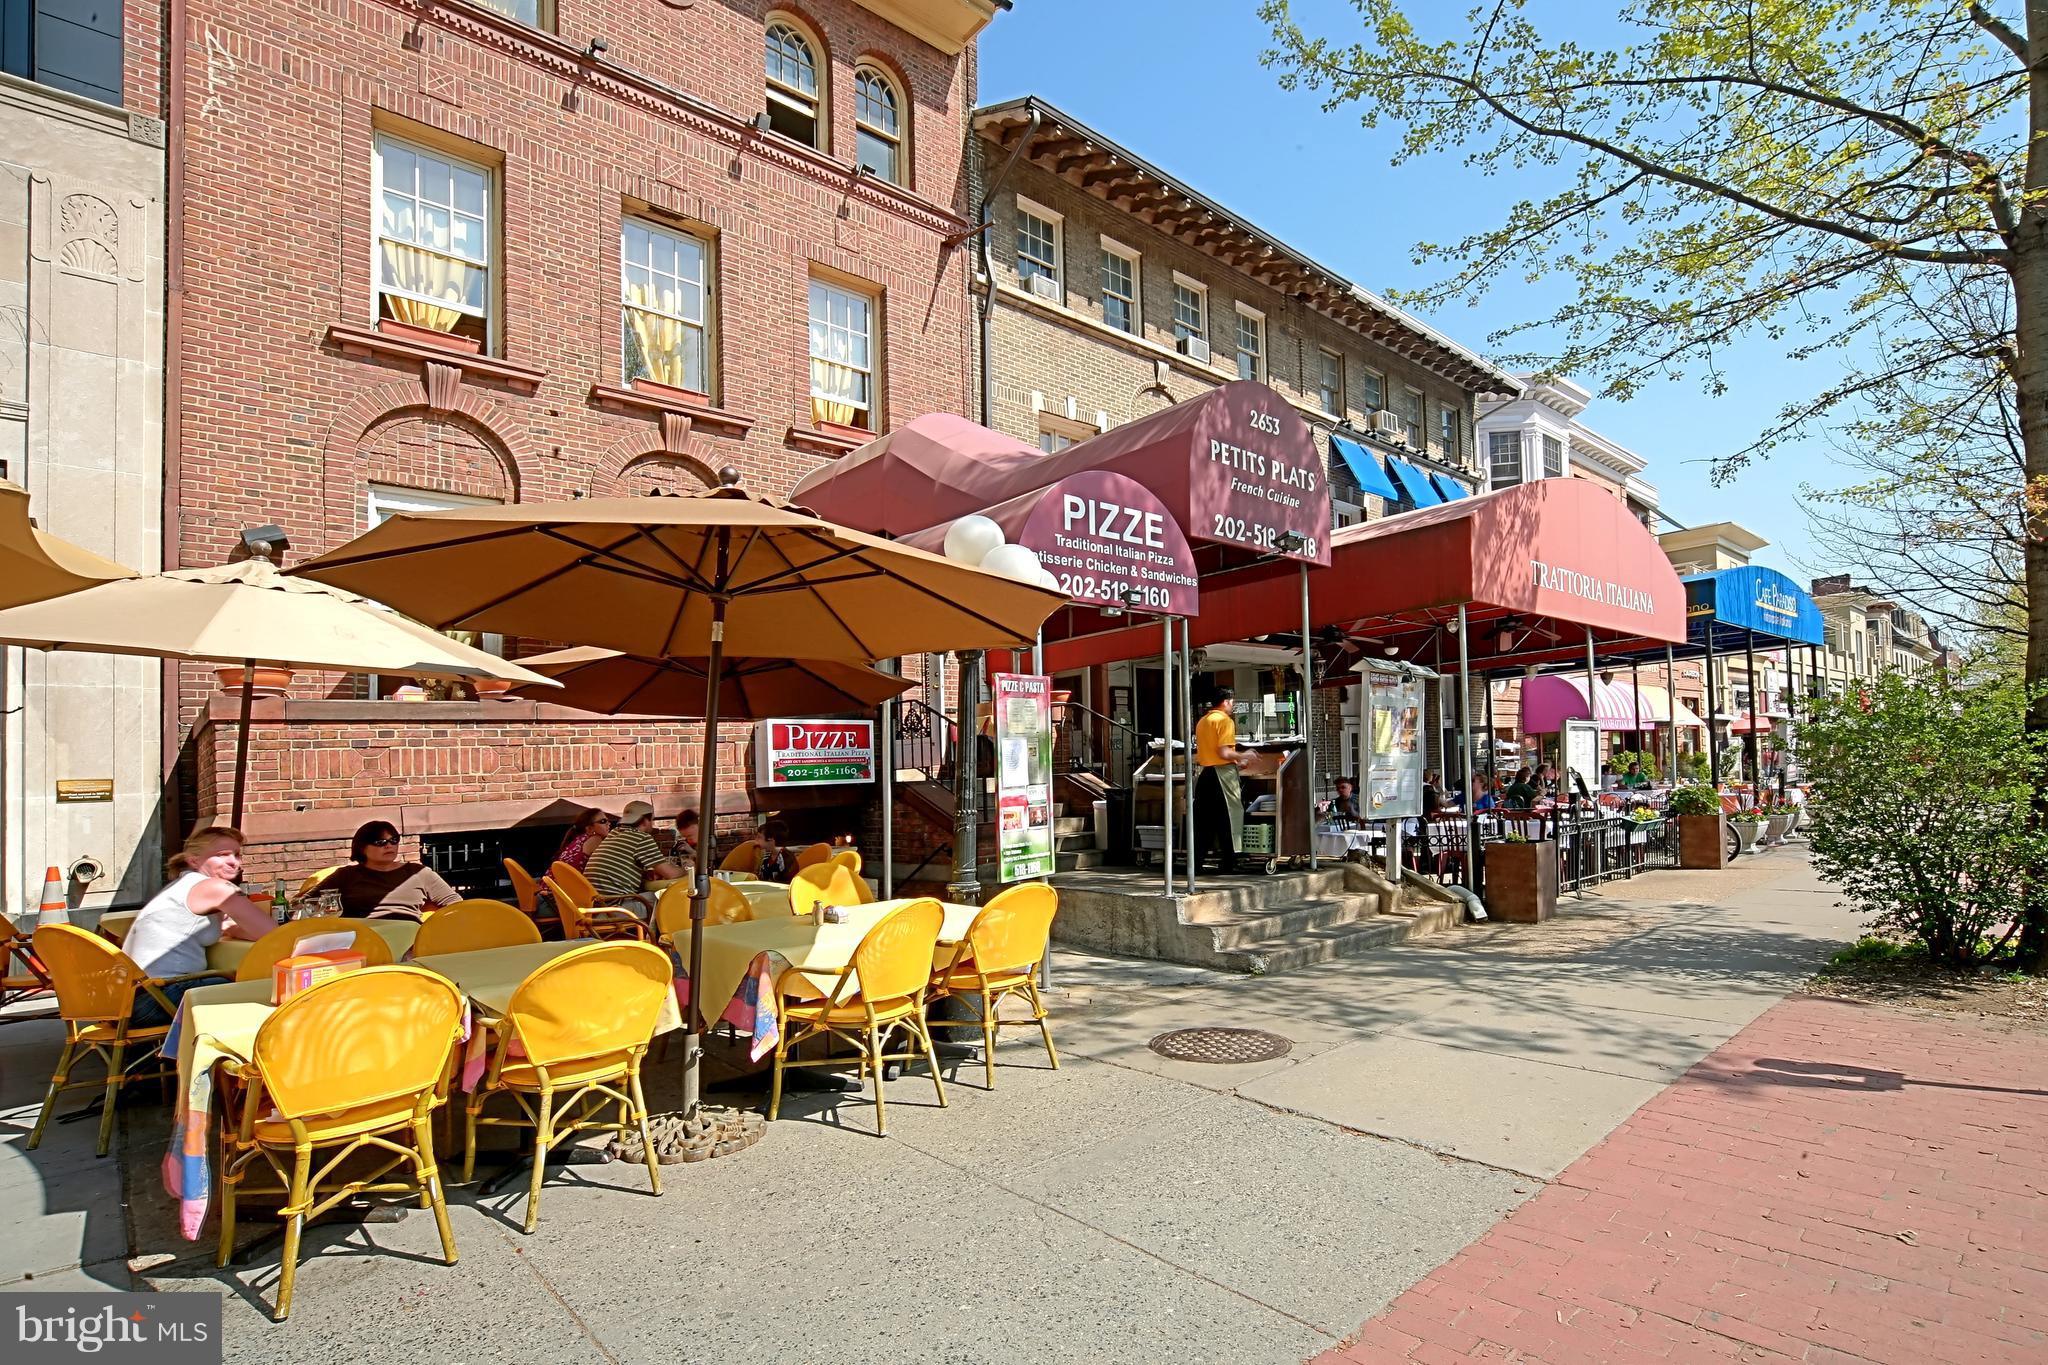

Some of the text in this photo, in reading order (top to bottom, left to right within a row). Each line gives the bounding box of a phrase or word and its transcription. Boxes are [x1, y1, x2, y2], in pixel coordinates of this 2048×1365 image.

[1249, 409, 1280, 436] 2653
[1210, 439, 1316, 492] PETITS PLATS
[1231, 477, 1300, 509] French Cuisine
[1063, 493, 1164, 549] PIZZE
[1214, 513, 1317, 558] 202-51818
[1054, 533, 1174, 566] Traditional Italian Pizza
[1034, 550, 1198, 587] tisserie Chicken & Sandwiches
[1060, 573, 1170, 608] 202-518160
[1529, 560, 1655, 615] TRATTORIA ITALIANA
[1001, 680, 1018, 692] PIZZE
[1025, 681, 1045, 693] PASTA
[785, 724, 858, 750] PIZZE
[788, 766, 857, 778] 202-518-1160
